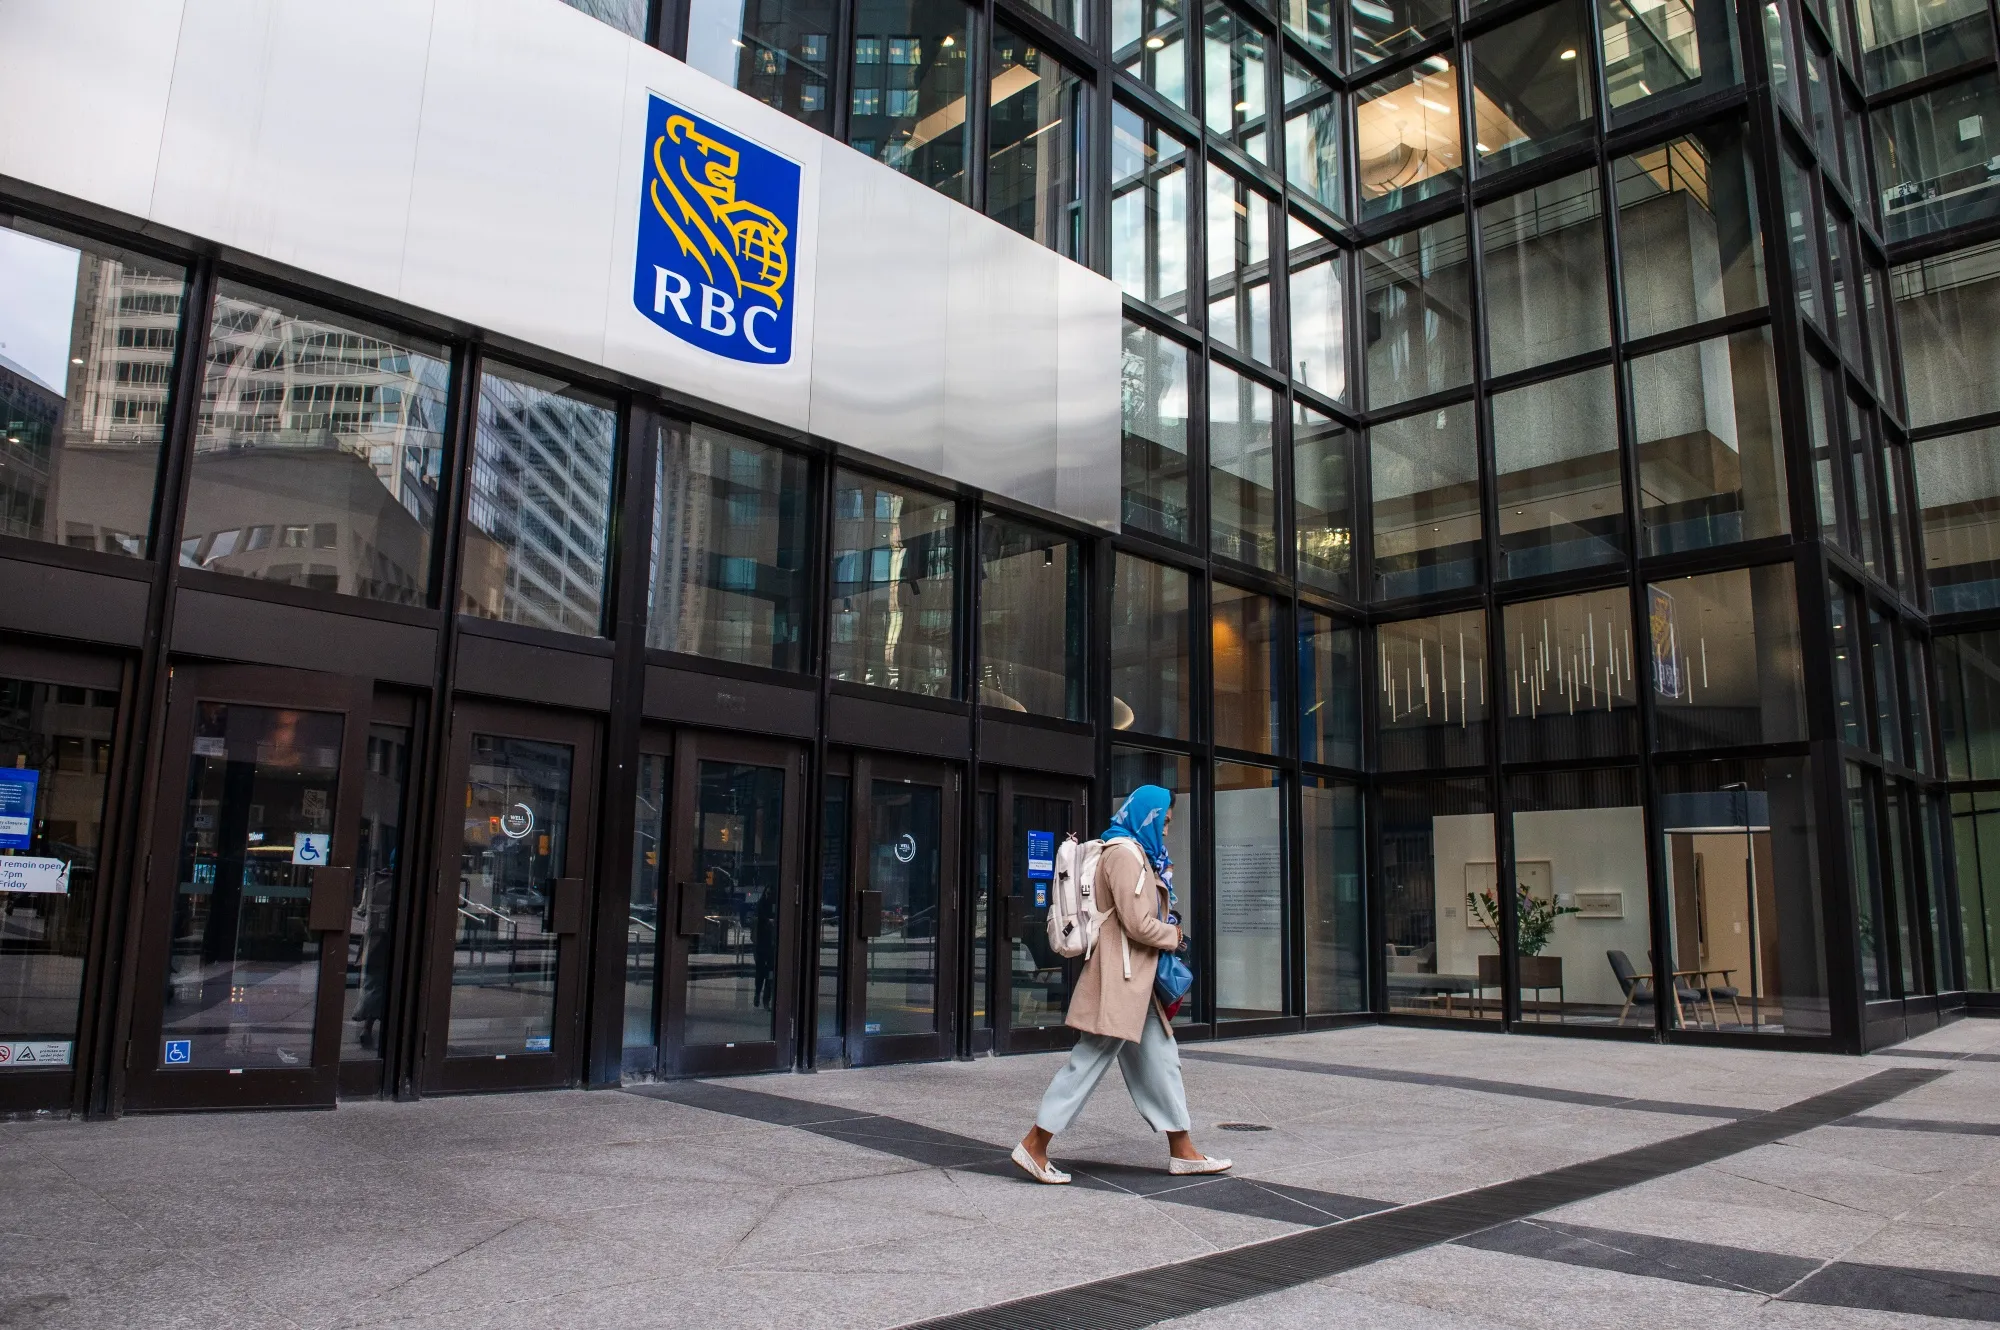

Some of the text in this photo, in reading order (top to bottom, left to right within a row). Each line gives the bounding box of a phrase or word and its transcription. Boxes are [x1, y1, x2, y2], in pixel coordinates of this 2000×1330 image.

[652, 264, 778, 354] RBC
[4, 860, 36, 869] remain
[38, 863, 62, 871] open
